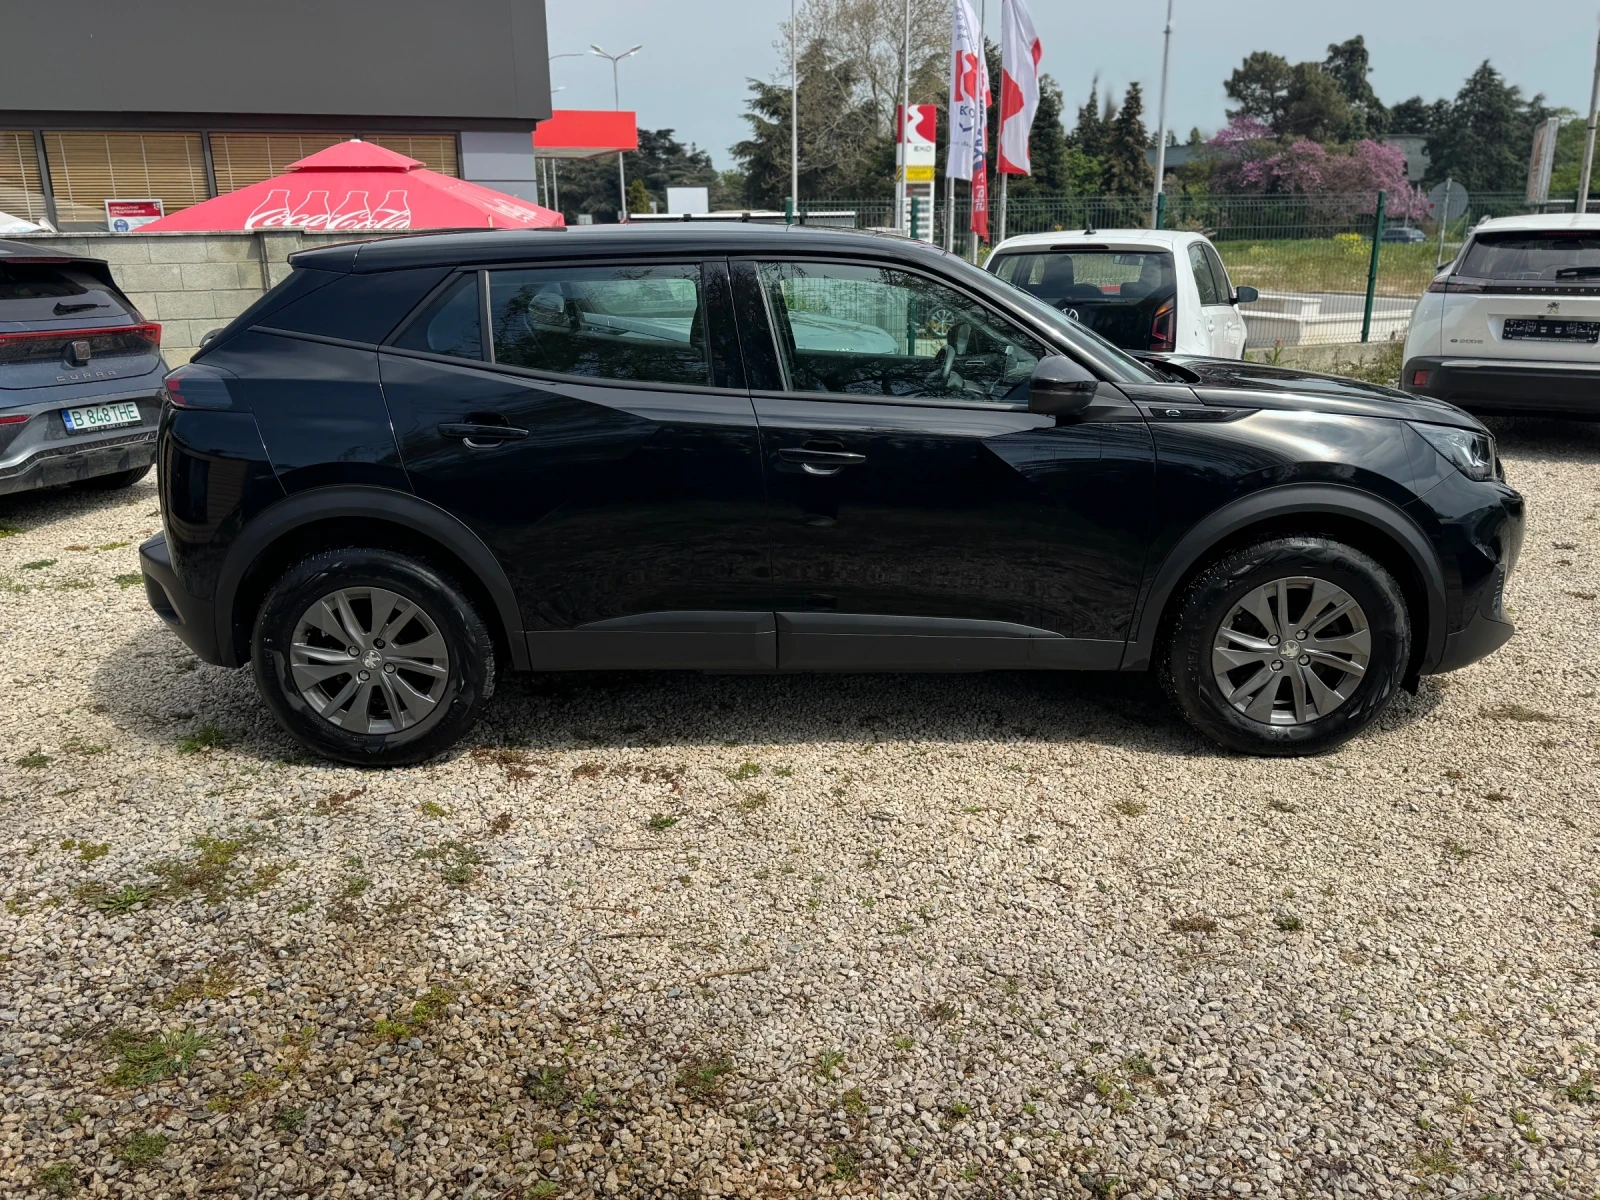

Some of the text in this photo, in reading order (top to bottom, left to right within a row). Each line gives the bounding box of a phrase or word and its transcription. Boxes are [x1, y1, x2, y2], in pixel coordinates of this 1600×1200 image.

[244, 207, 412, 230] Coca-Cola
[55, 370, 117, 382] CUPRA
[71, 410, 85, 427] B
